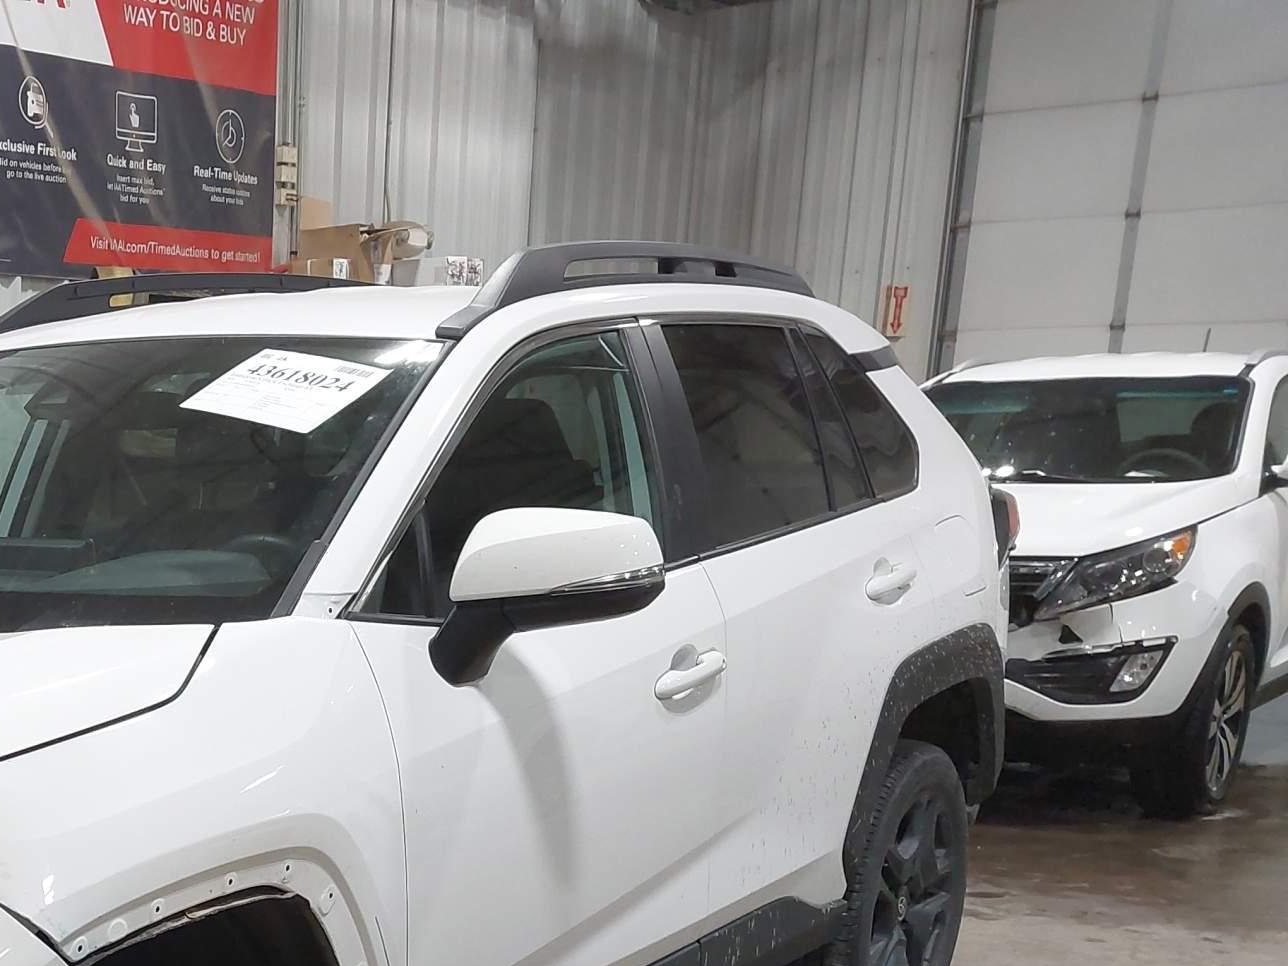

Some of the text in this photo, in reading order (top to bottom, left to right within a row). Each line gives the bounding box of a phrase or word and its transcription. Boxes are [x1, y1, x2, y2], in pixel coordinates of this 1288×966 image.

[212, 0, 222, 18] A
[225, 1, 255, 25] NEW
[123, 4, 157, 27] WAY
[160, 11, 180, 32] TO
[183, 16, 203, 37] BID
[206, 21, 216, 40] &
[219, 24, 246, 46] BUY
[37, 142, 56, 157] First
[9, 159, 18, 168] on
[19, 160, 42, 170] vehicles
[106, 153, 166, 175] Quick and Easy
[193, 165, 258, 185] Real-Time Updates
[6, 169, 14, 179] go
[16, 170, 23, 178] to
[45, 173, 67, 184] auction
[90, 235, 109, 250] Visit
[211, 247, 220, 260] to
[221, 250, 233, 263] get
[234, 250, 261, 263] started!
[247, 363, 356, 393] 43618024
